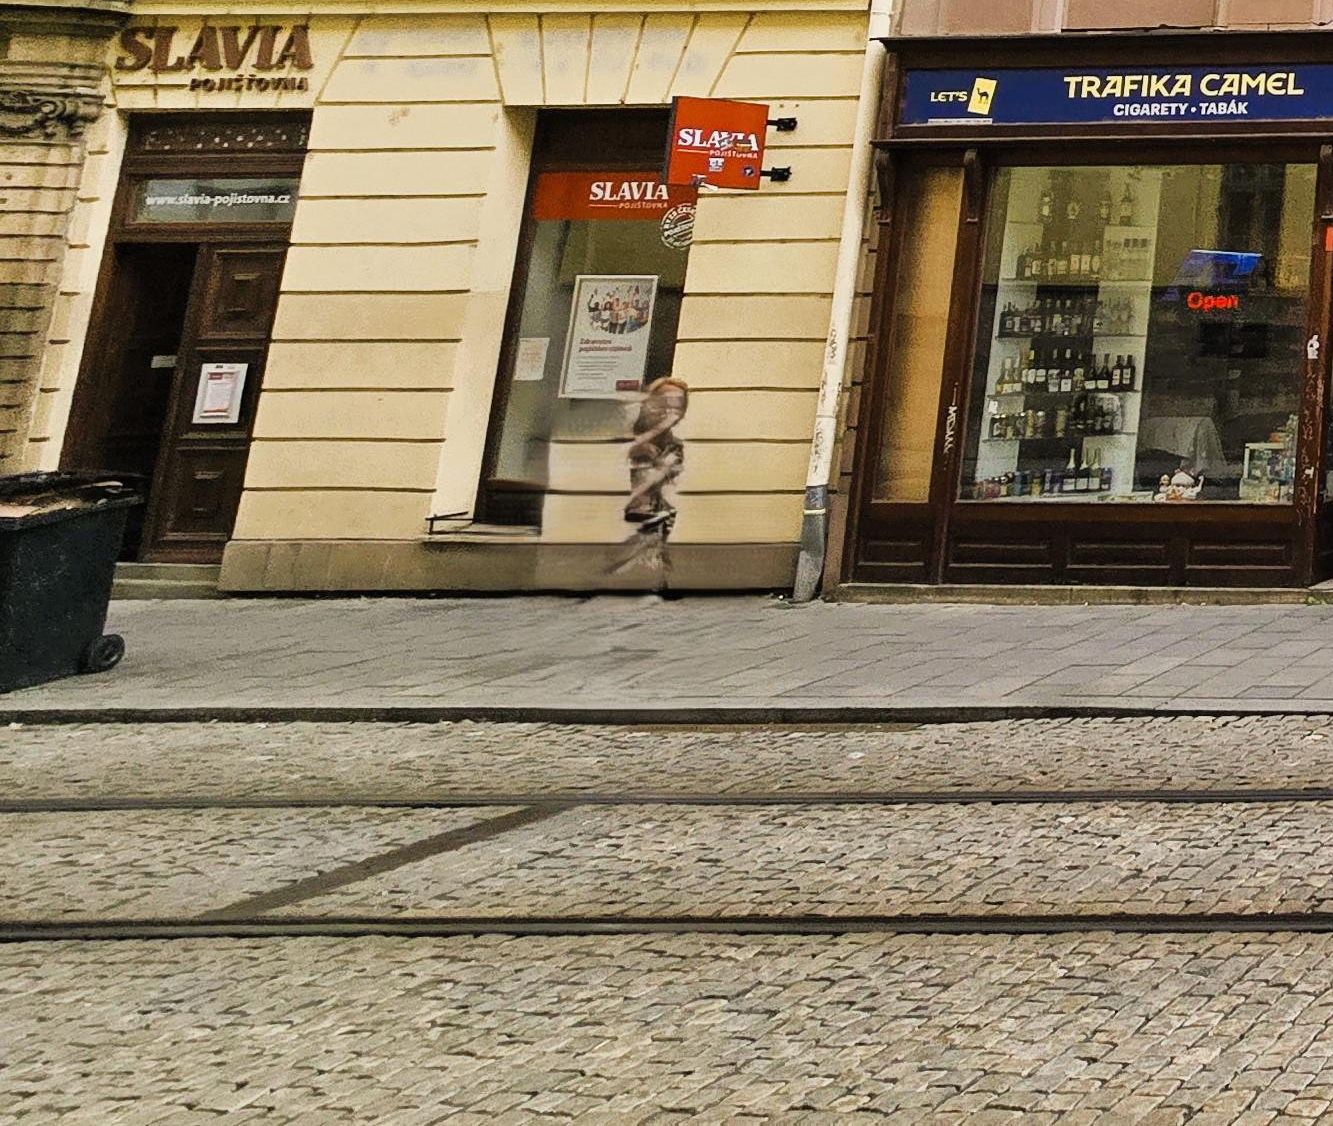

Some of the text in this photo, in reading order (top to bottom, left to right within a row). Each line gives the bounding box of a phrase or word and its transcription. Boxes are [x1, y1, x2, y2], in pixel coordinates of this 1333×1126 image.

[114, 25, 314, 71] SLAVIA
[188, 74, 309, 92] POJIŠŤOVNA
[1063, 72, 1304, 99] TRAFIKA CAMEL
[930, 91, 968, 102] LET'S
[1113, 99, 1249, 116] CIGARETY TABÁK
[145, 192, 291, 208] www.slavia-pojistovna.cz
[589, 181, 669, 201] SLAVIA
[1186, 292, 1239, 312] Open
